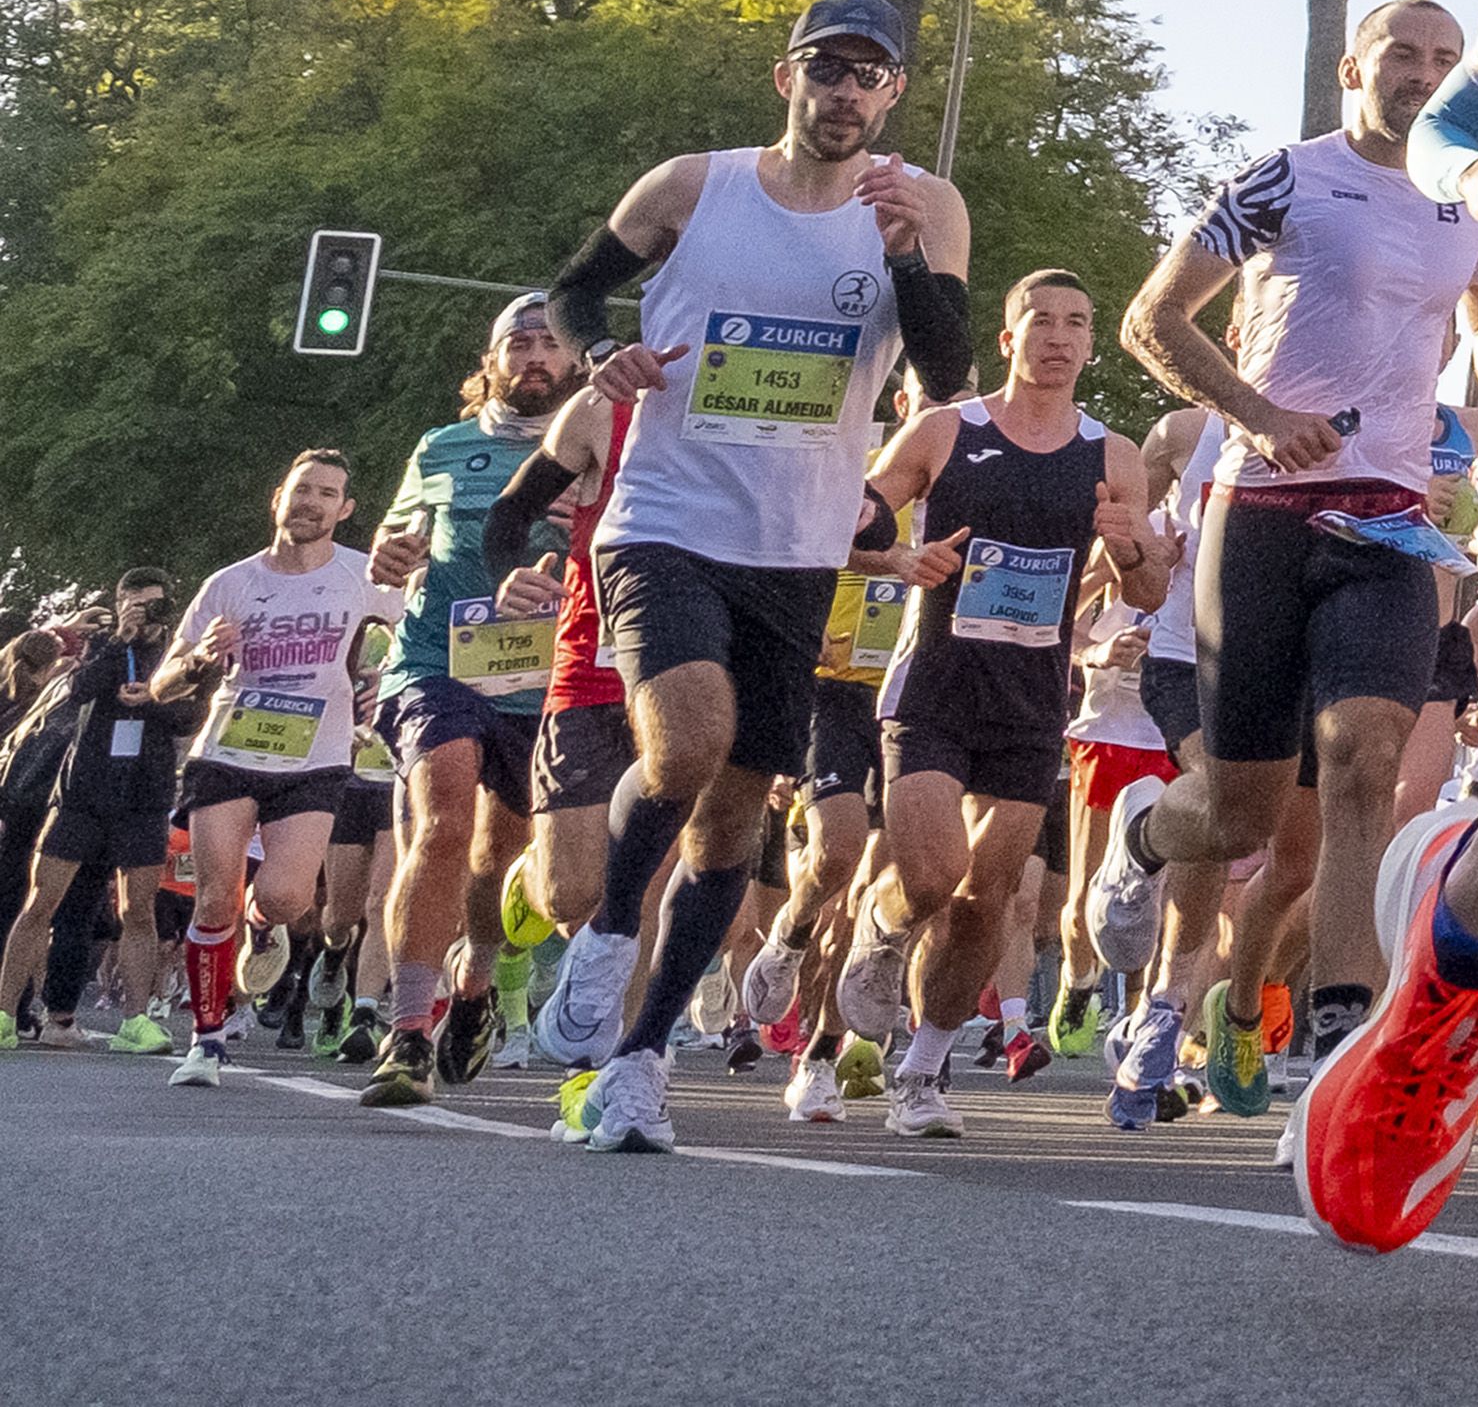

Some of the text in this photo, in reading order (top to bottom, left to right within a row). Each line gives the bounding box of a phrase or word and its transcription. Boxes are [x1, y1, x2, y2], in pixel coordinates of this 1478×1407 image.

[759, 325, 845, 349] ZURICH
[752, 368, 802, 390] 1453
[702, 390, 834, 418] CÉSAR ALMEIDA
[1008, 554, 1062, 572] ZURICH
[1000, 583, 1037, 604] 3954
[263, 694, 316, 715] ZURICH
